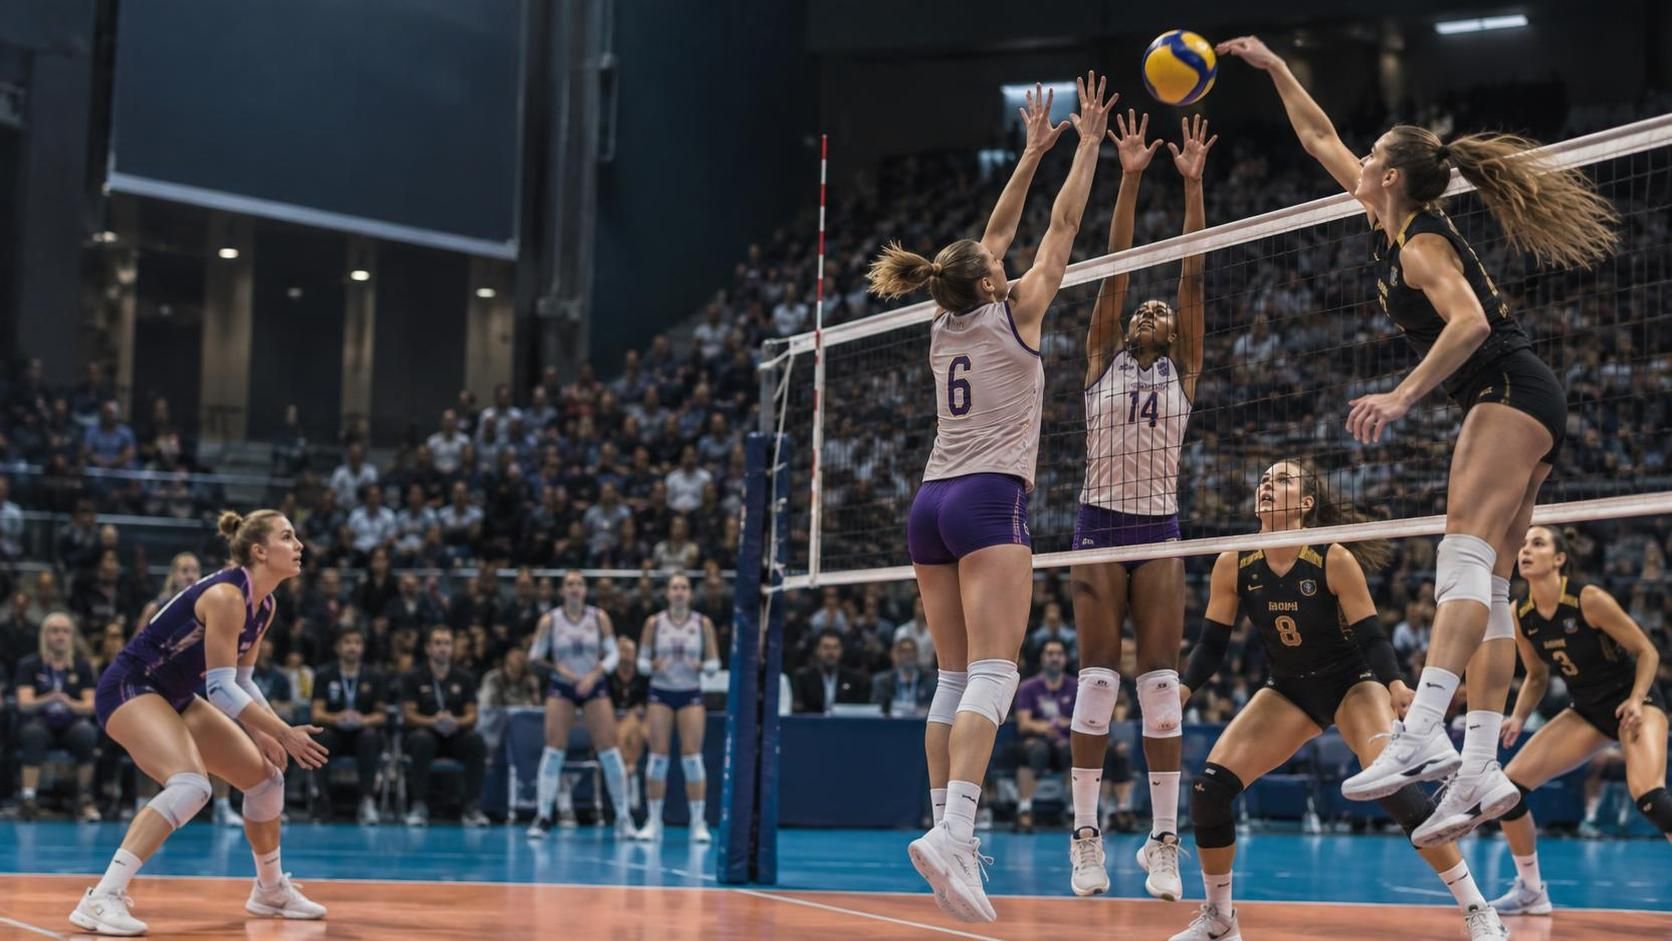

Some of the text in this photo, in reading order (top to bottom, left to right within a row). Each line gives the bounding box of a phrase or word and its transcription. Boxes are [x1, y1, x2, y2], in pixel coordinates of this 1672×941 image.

[947, 355, 972, 416] 6
[1128, 391, 1158, 427] 14
[1275, 615, 1302, 647] 8
[1552, 650, 1579, 676] 3
